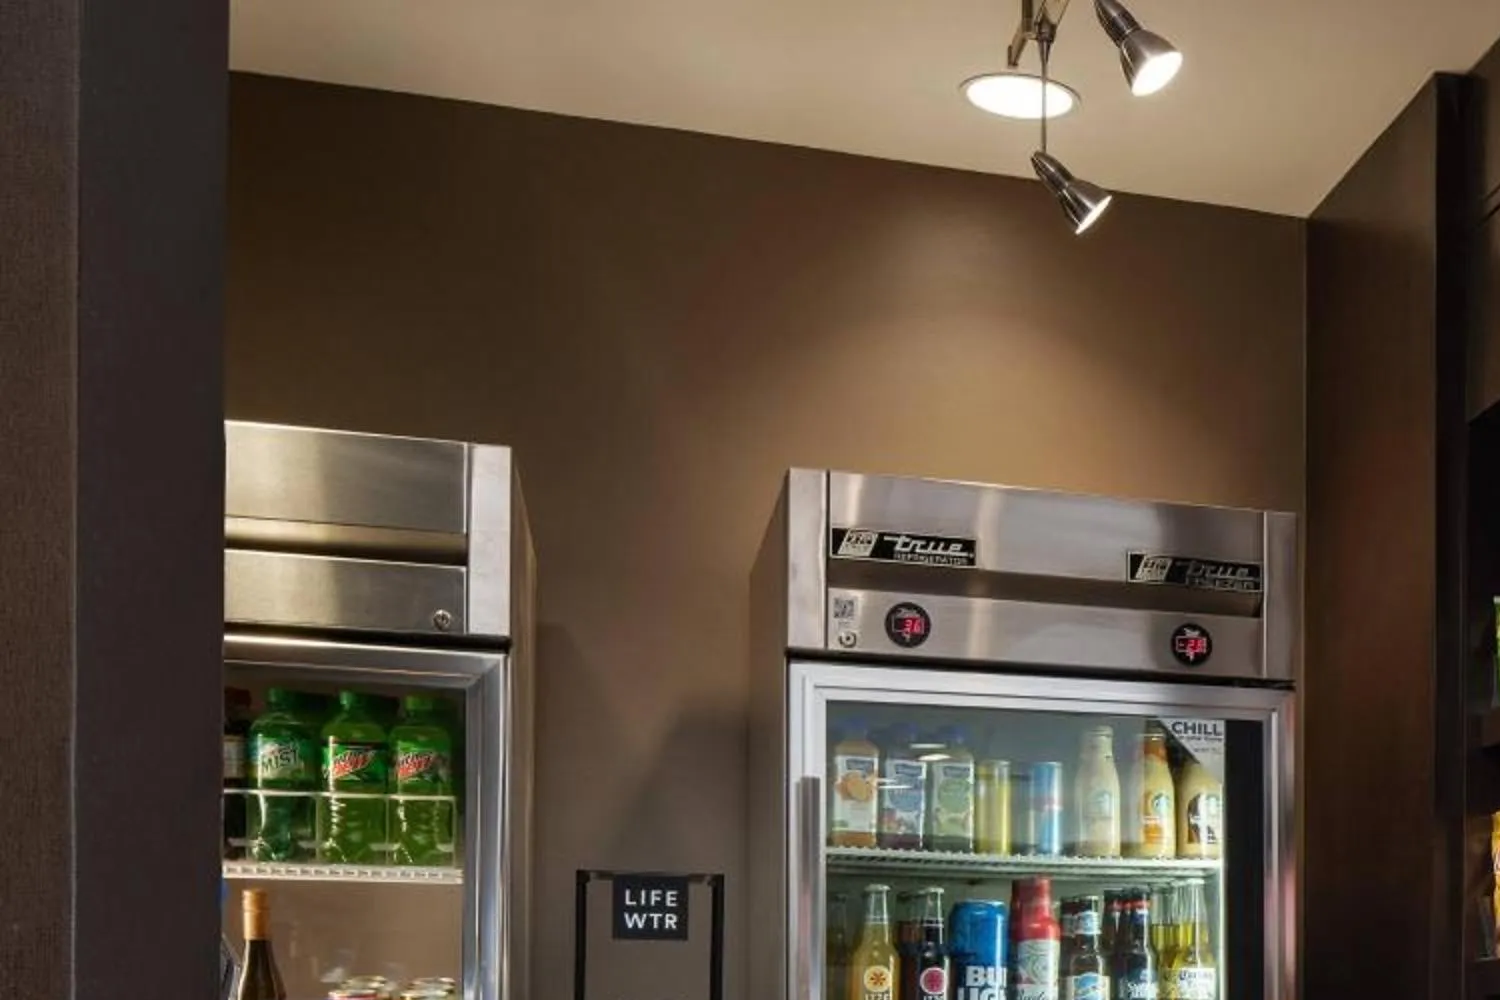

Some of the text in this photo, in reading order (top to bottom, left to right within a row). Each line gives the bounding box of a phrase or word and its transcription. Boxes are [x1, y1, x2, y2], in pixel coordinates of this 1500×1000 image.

[1171, 721, 1222, 736] CHILL
[624, 889, 678, 907] LIFE
[624, 912, 678, 930] WTR
